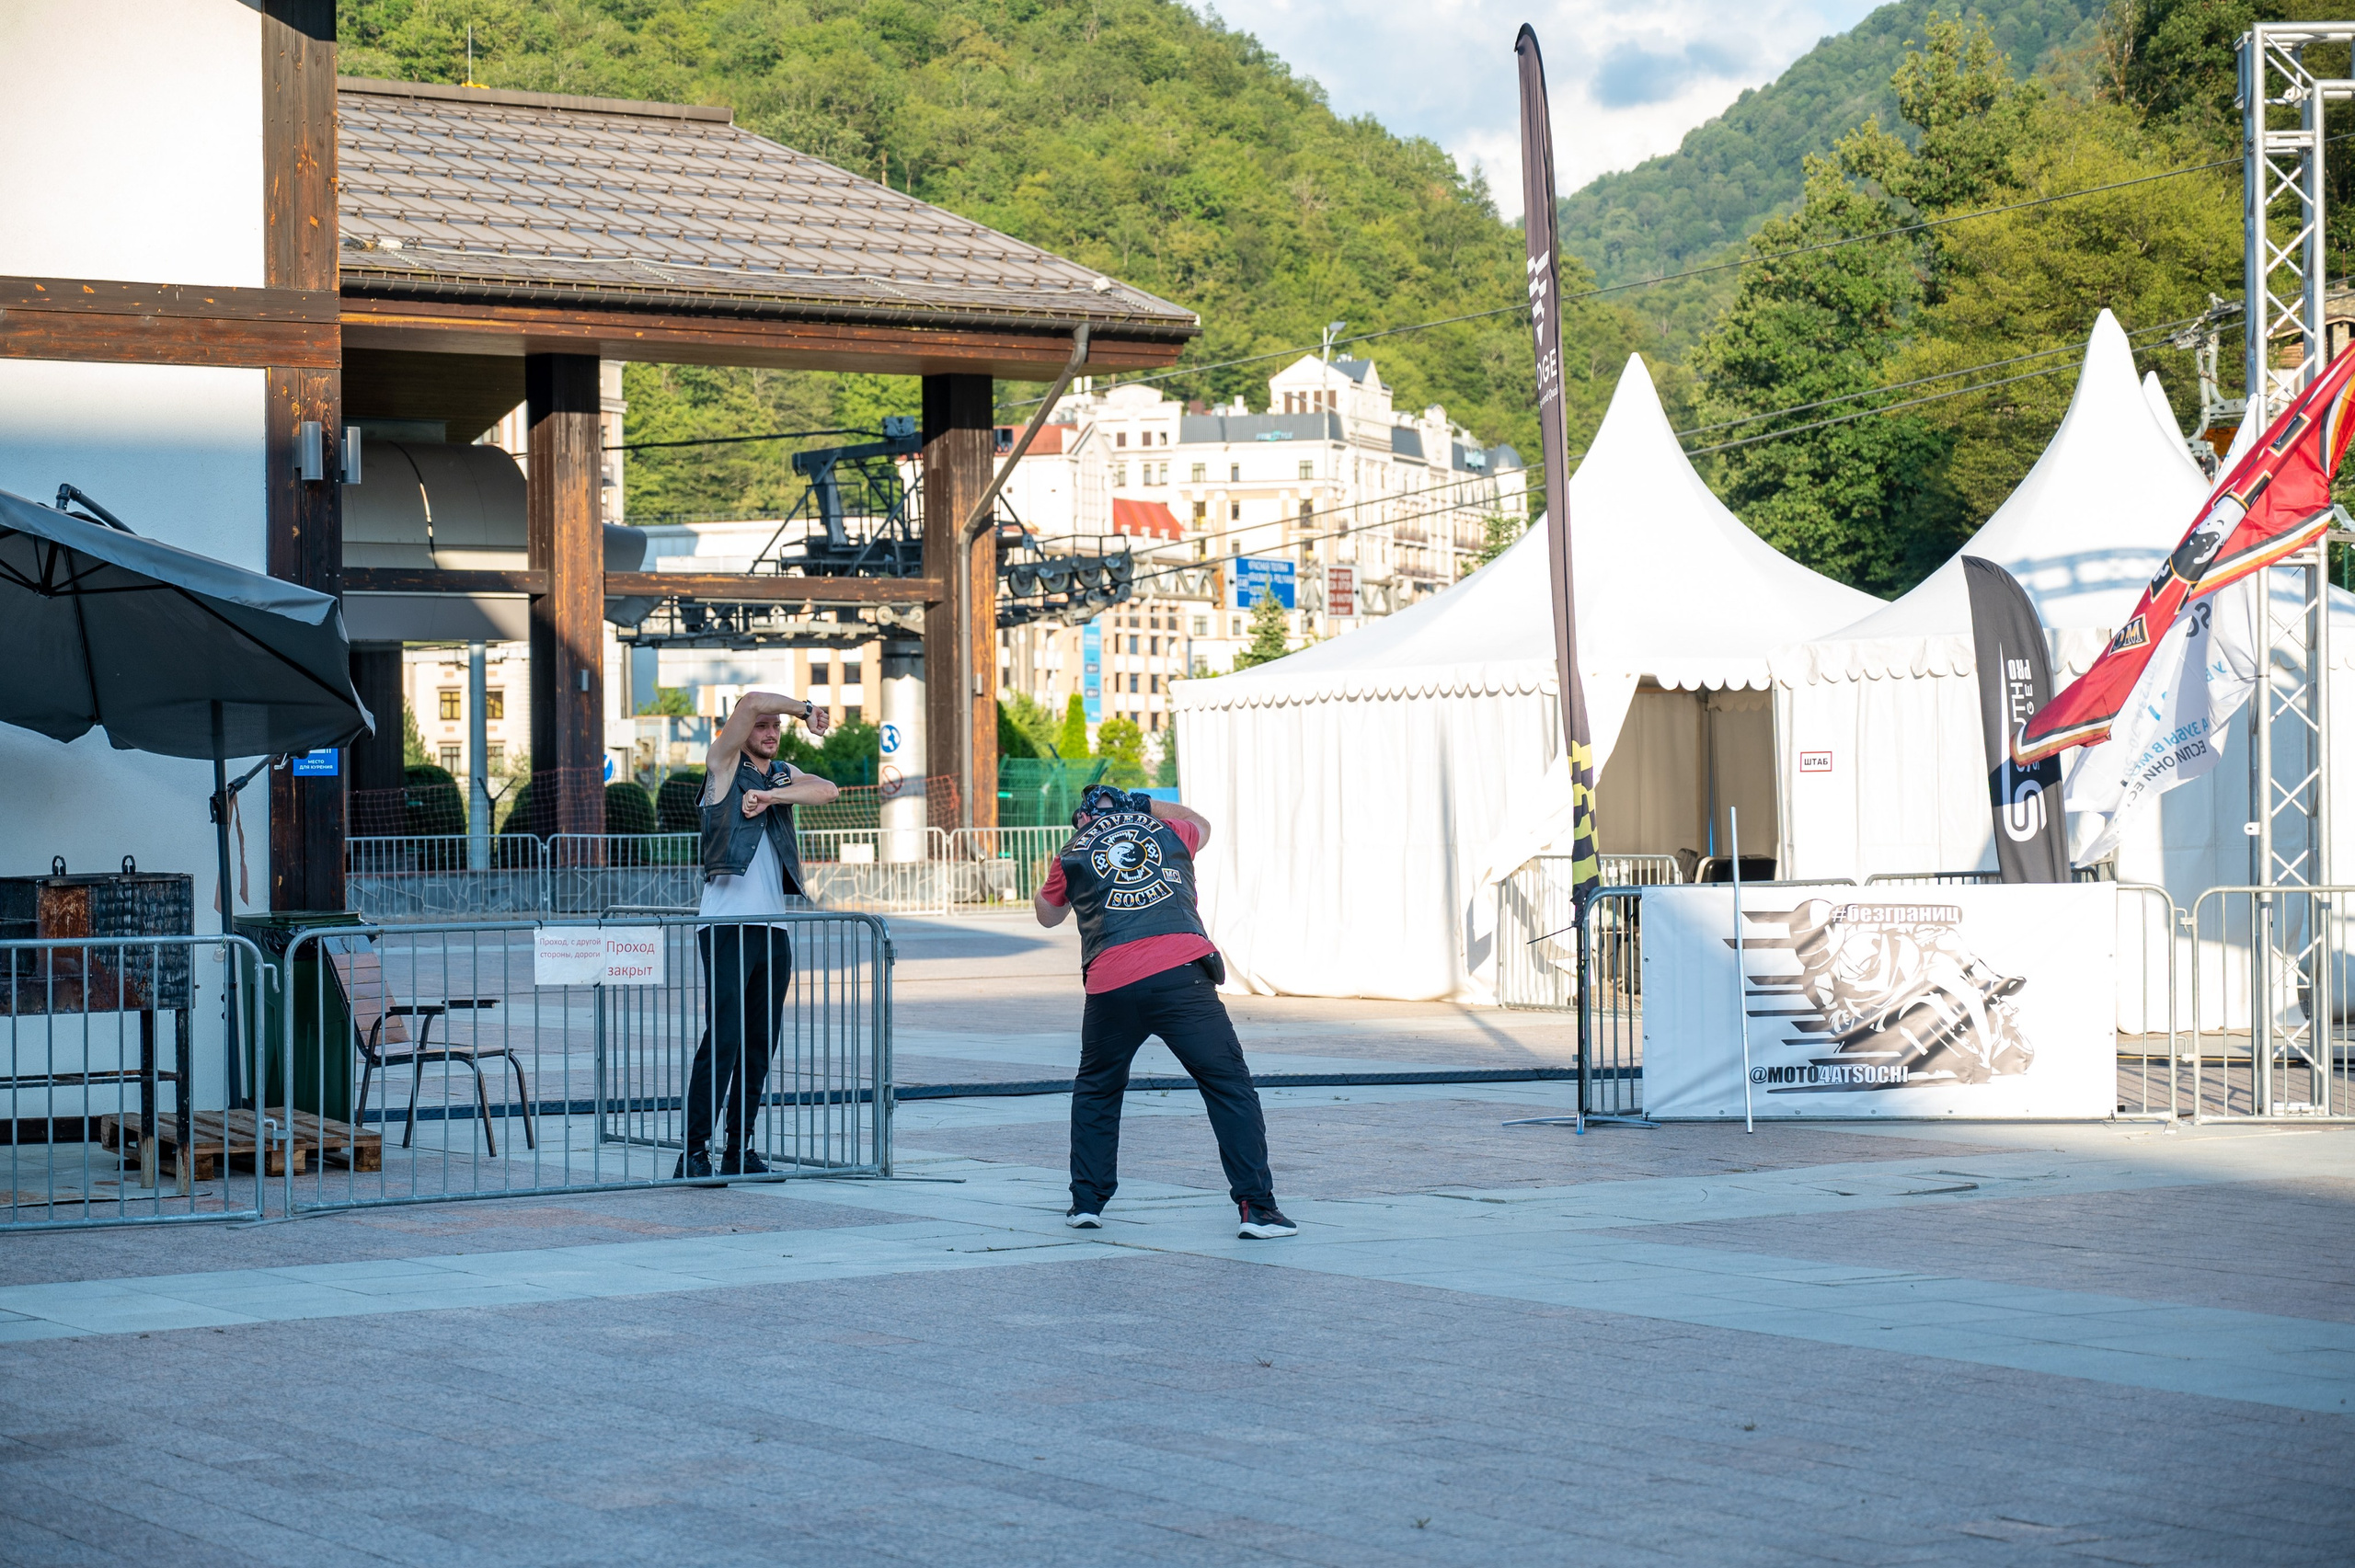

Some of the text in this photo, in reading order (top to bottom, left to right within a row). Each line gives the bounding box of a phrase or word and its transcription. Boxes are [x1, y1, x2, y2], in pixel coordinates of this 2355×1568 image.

[1076, 815, 1157, 847] MEDVEDI
[1164, 870, 1178, 881] MC
[1111, 884, 1167, 908] SOCHI
[1832, 904, 1960, 924] #безграниц
[539, 937, 569, 947] Проход,
[576, 937, 602, 947] другой
[606, 940, 655, 956] Проход
[540, 951, 601, 959] стороны, дороги
[607, 966, 653, 979] закрыт
